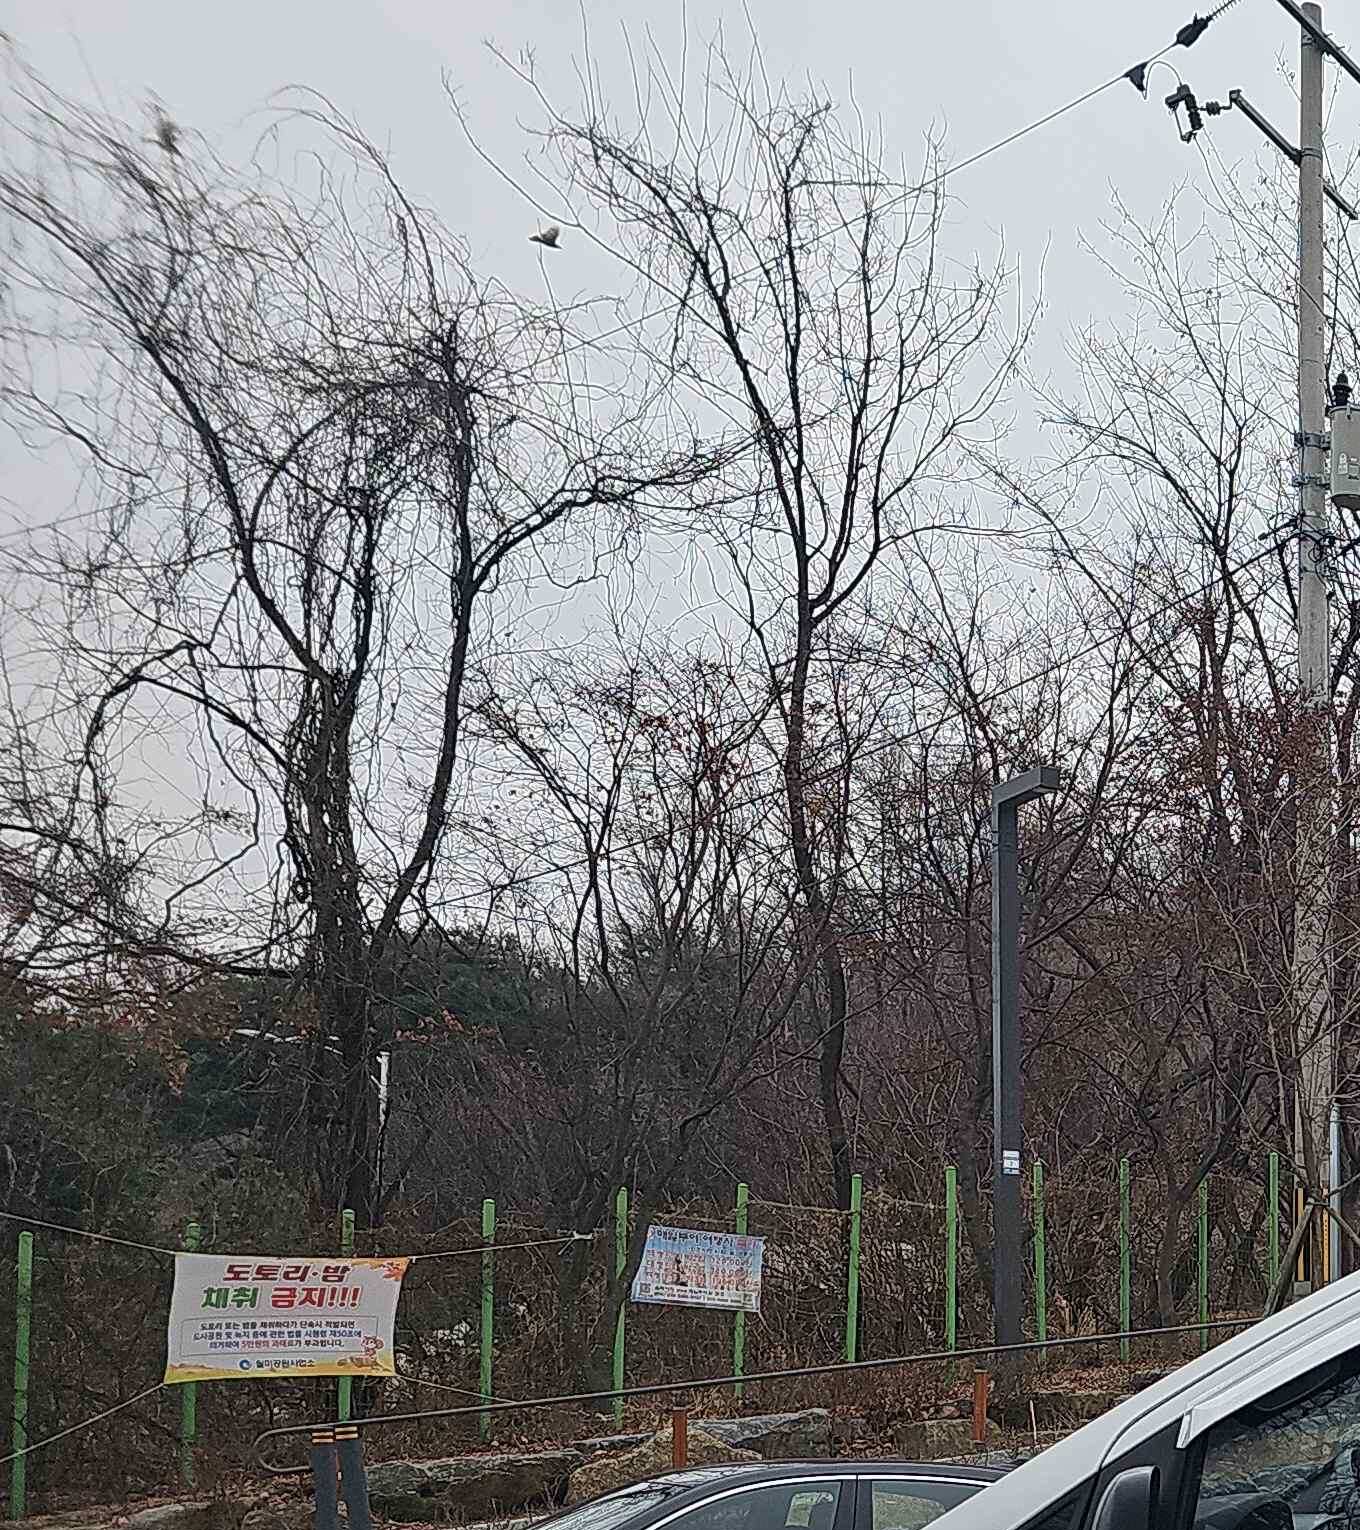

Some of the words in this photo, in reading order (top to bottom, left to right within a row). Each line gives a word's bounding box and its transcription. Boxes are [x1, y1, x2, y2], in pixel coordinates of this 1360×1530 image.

[201, 1286, 259, 1309] 채취
[271, 1286, 361, 1309] 금지!!!
[200, 1321, 223, 1331] 도토리
[225, 1321, 241, 1330] 또는
